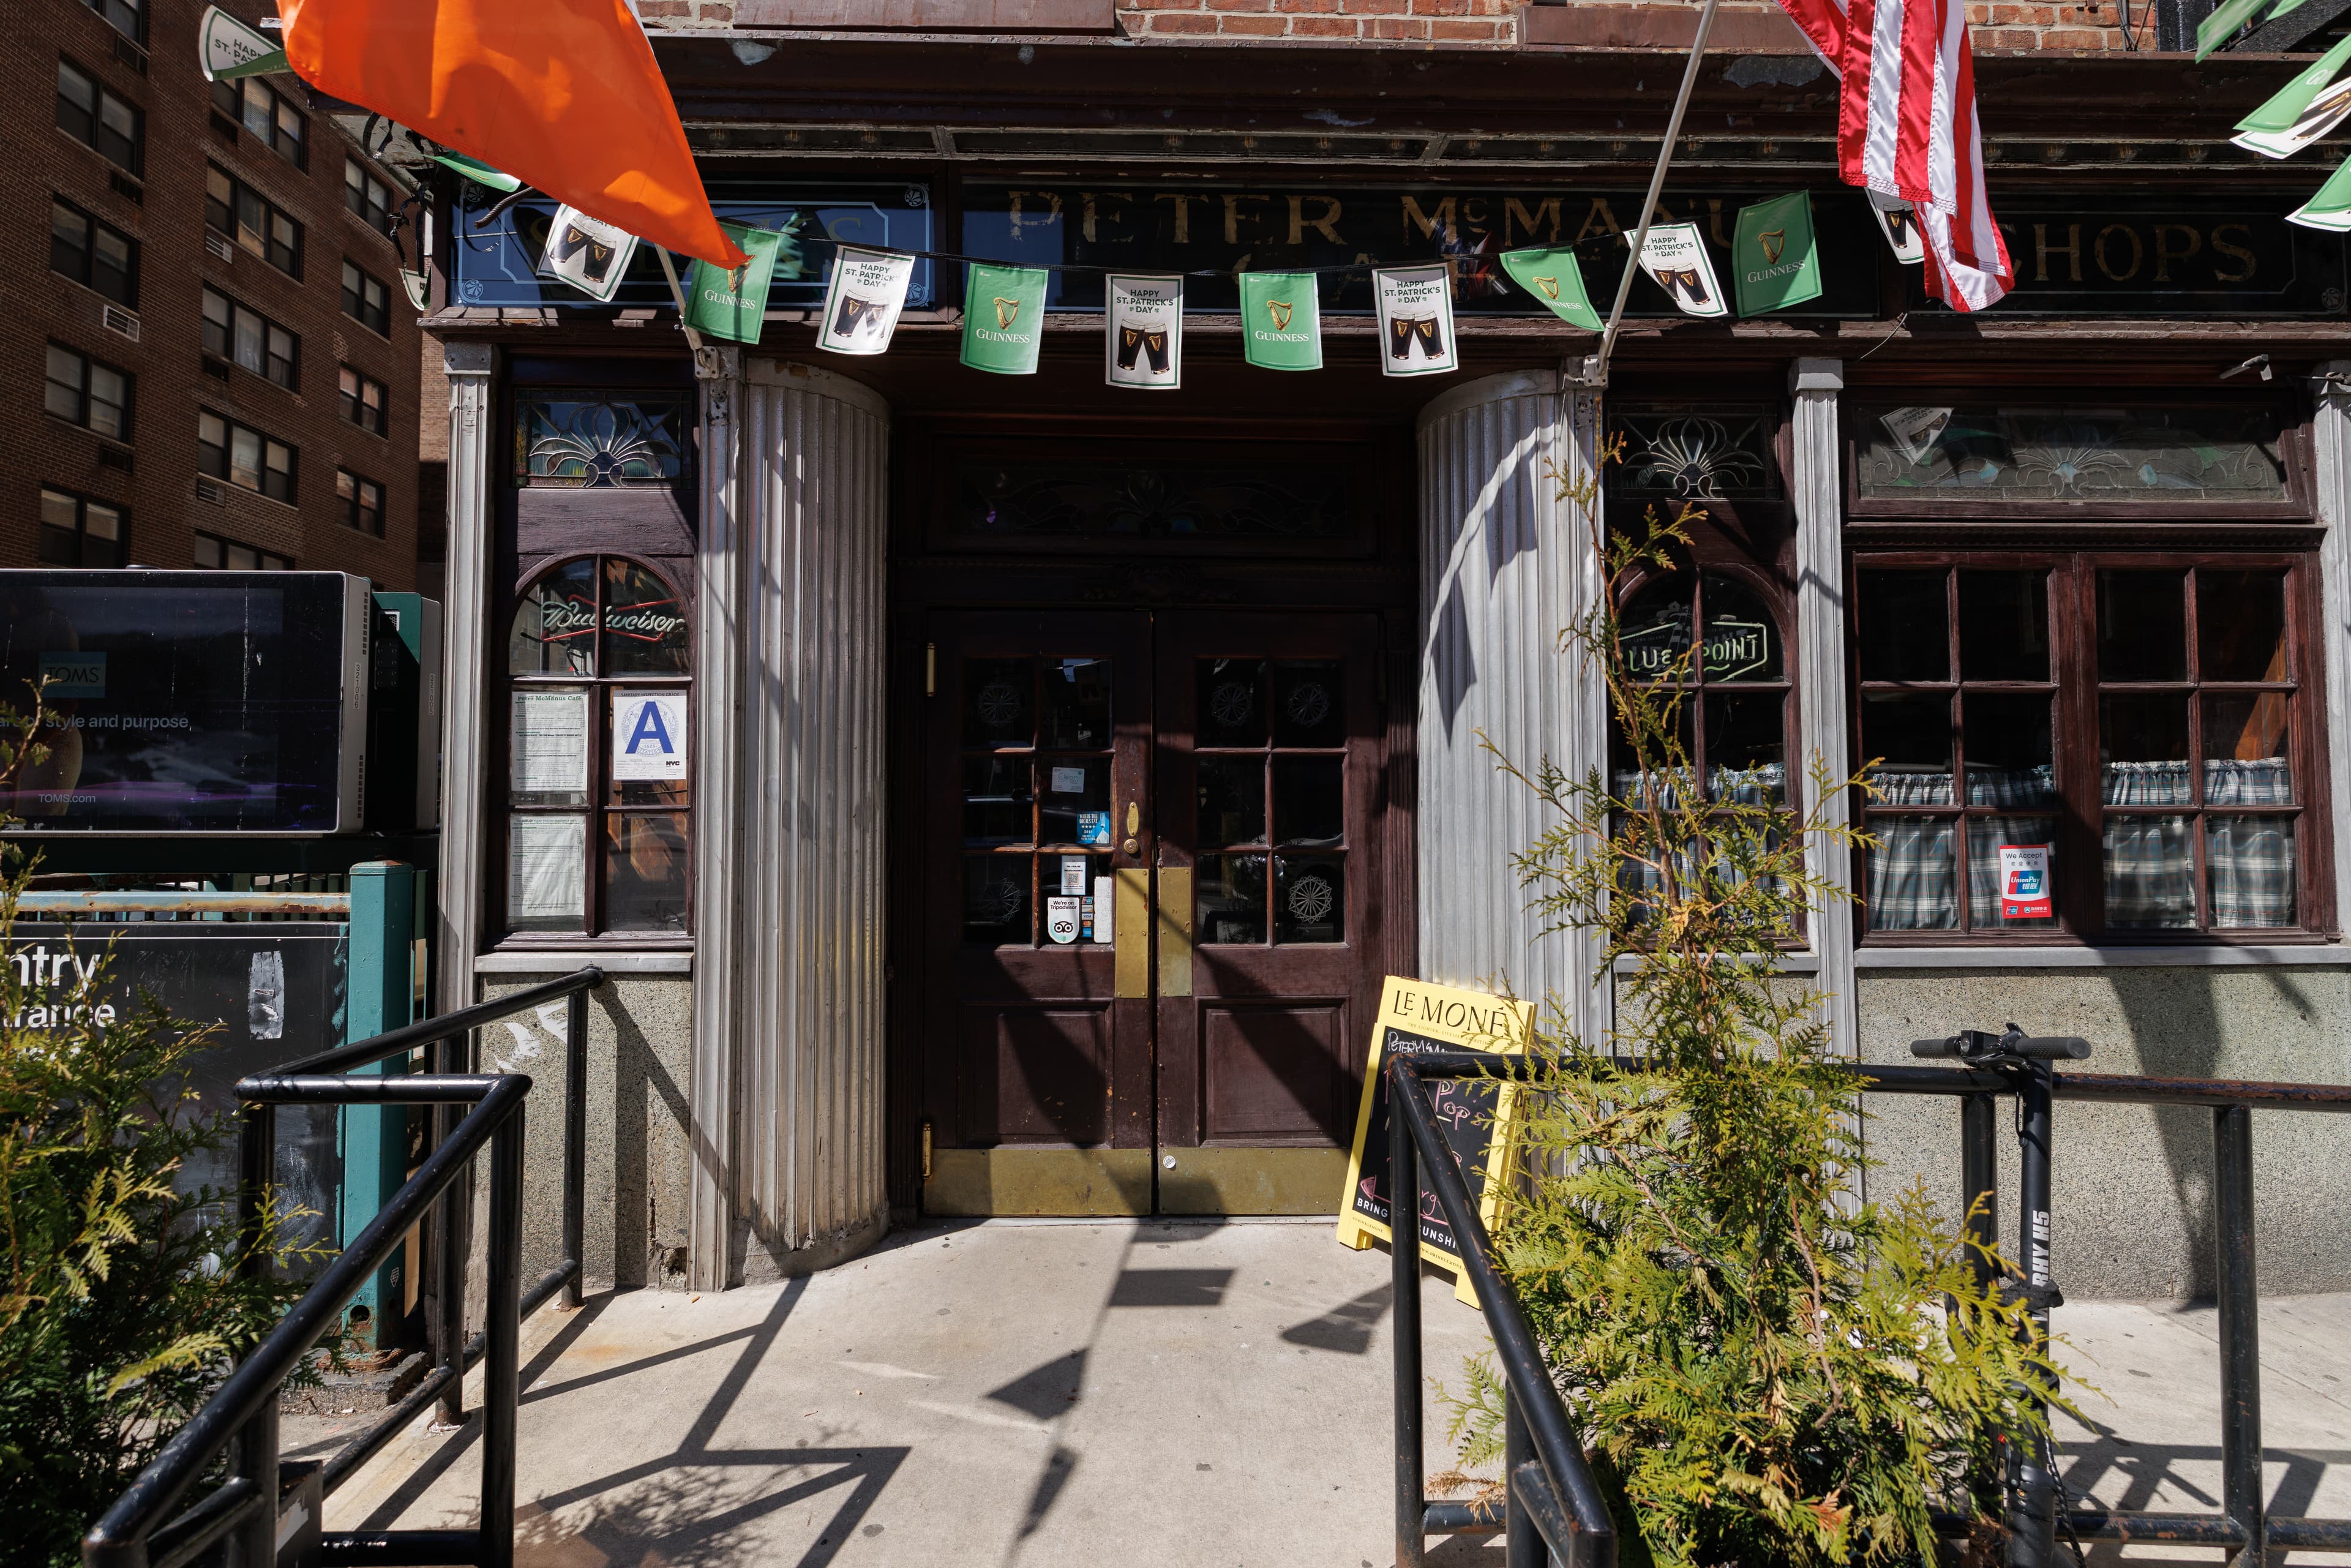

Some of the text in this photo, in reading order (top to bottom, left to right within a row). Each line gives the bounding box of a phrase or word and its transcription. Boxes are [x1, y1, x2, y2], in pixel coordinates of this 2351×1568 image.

[215, 39, 231, 55] ST.
[234, 39, 263, 58] HAP
[1007, 190, 1347, 245] PETER
[861, 263, 890, 274] HAPPY
[1747, 260, 1805, 283] GUINNESS
[705, 290, 756, 309] GUINNESS
[1398, 287, 1440, 296] PATRICK'S
[976, 328, 1030, 343] GUINNESS
[1255, 331, 1309, 342] GUINNESS
[45, 667, 99, 683] TOMS
[45, 714, 84, 731] style
[89, 715, 118, 727] and
[122, 716, 189, 730] purpose
[624, 701, 675, 754] A
[39, 793, 96, 803] TOMS.com
[2011, 876, 2040, 885] UnionPay
[1393, 990, 1507, 1038] LE MONÉ
[1357, 1198, 1388, 1218] BRING
[2032, 1210, 2050, 1241] H5
